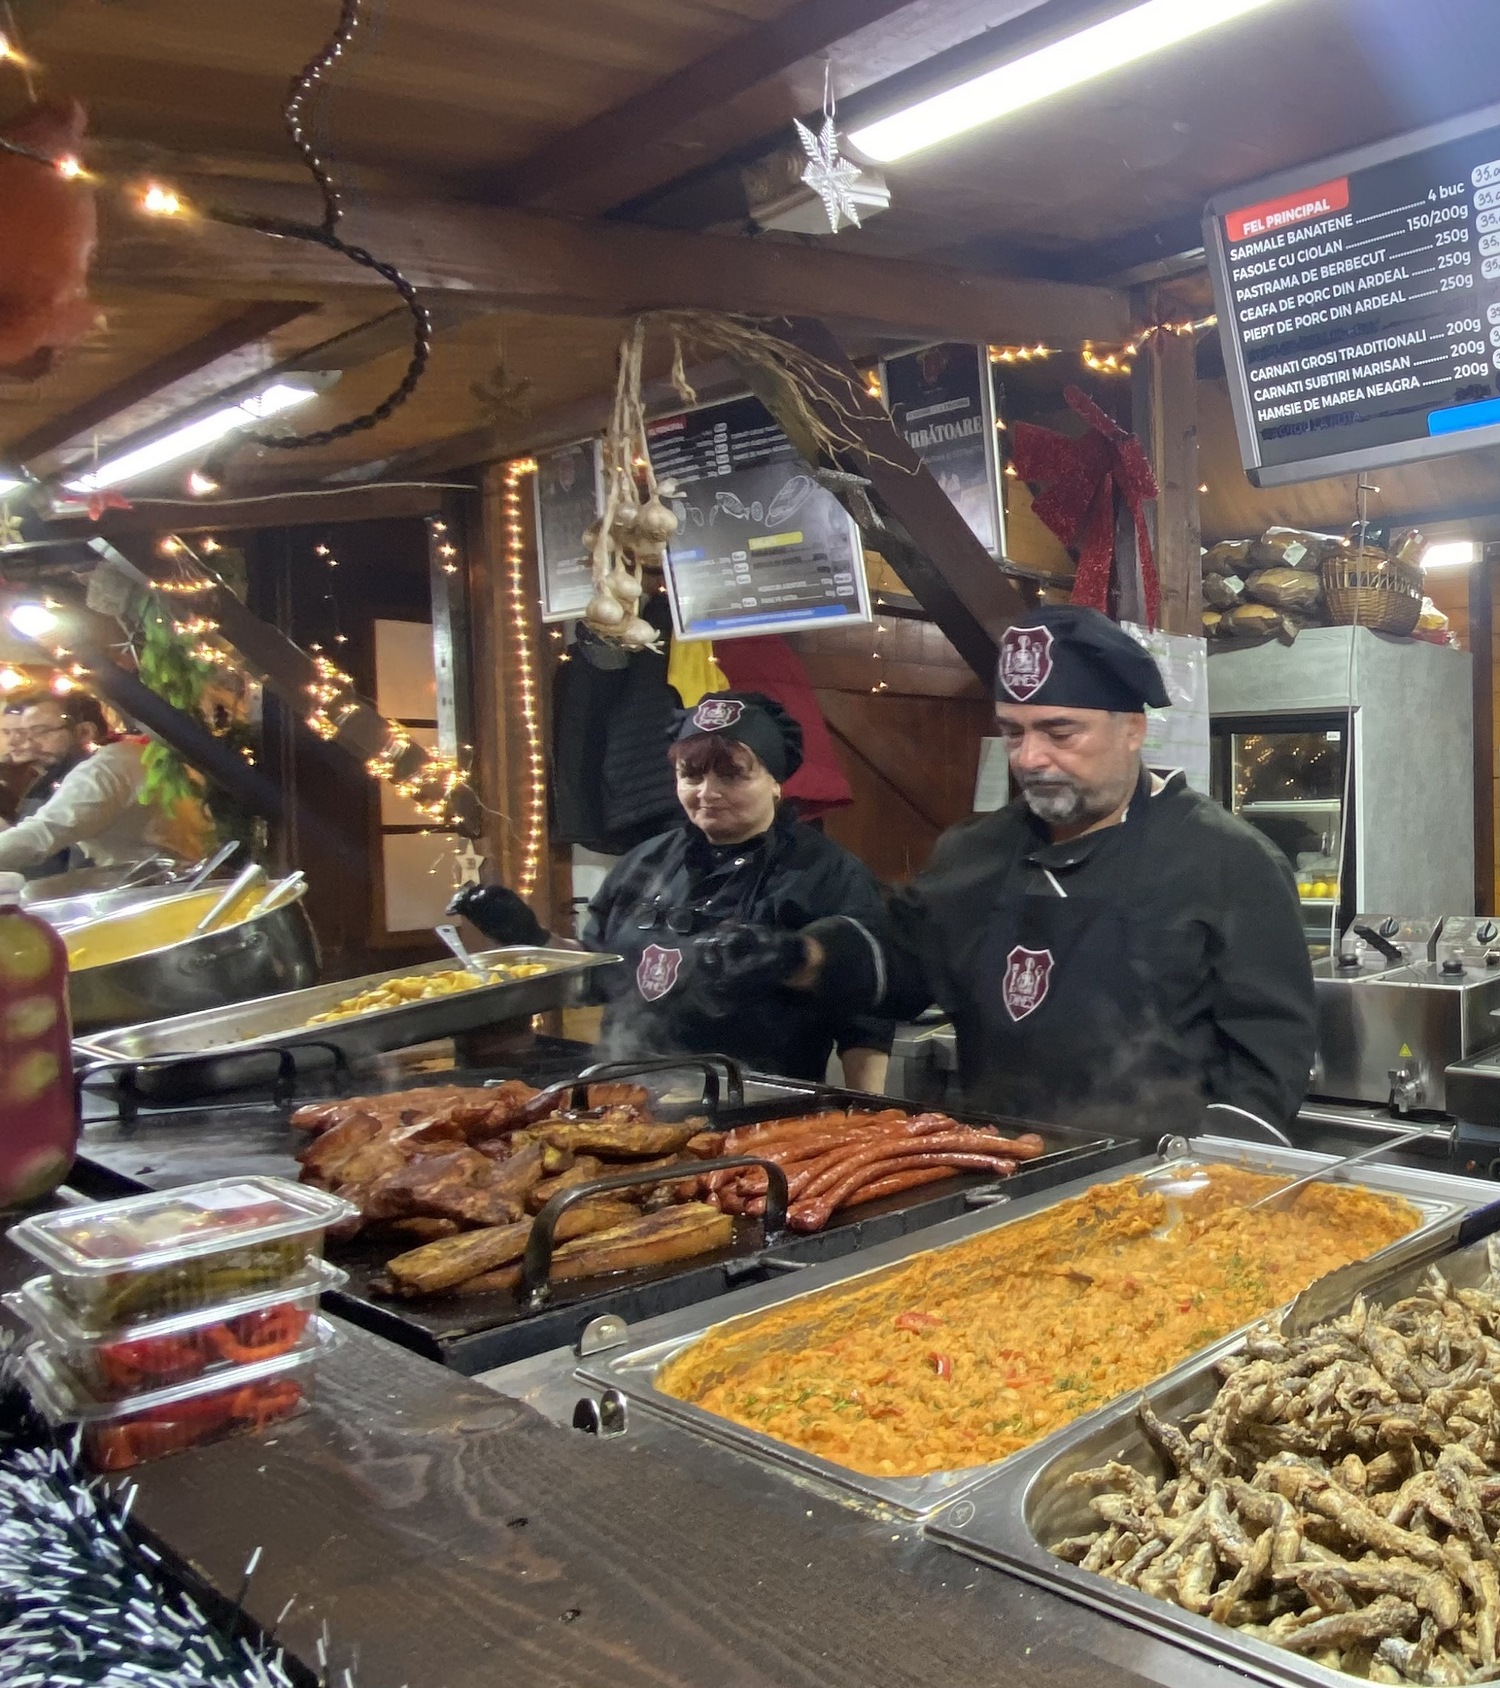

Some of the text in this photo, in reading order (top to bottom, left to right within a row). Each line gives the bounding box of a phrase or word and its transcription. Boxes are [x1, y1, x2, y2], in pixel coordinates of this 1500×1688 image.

[1230, 182, 1465, 261] SARMALE BANATENE 4 buc
[1233, 204, 1468, 282] FASOLE CU CIOLAN 150/200g
[1243, 198, 1331, 235] FEL PRINCIPAL
[1236, 228, 1469, 302] PASTRAMA DE BERBECUT 250g
[1240, 251, 1471, 322] CEAFA DE PORC DIN ARDEAL 250g
[1243, 274, 1473, 343] PIEPT DE PORC DIN ARDEAL 250g
[1250, 318, 1481, 382] CARNATI GROSI TRADITIONALI 200g
[1254, 340, 1485, 402] CARNATI SUBTIRI MARISAN 200g
[1257, 362, 1489, 422] HAMSIE DE MAREA NEAGRA 200g
